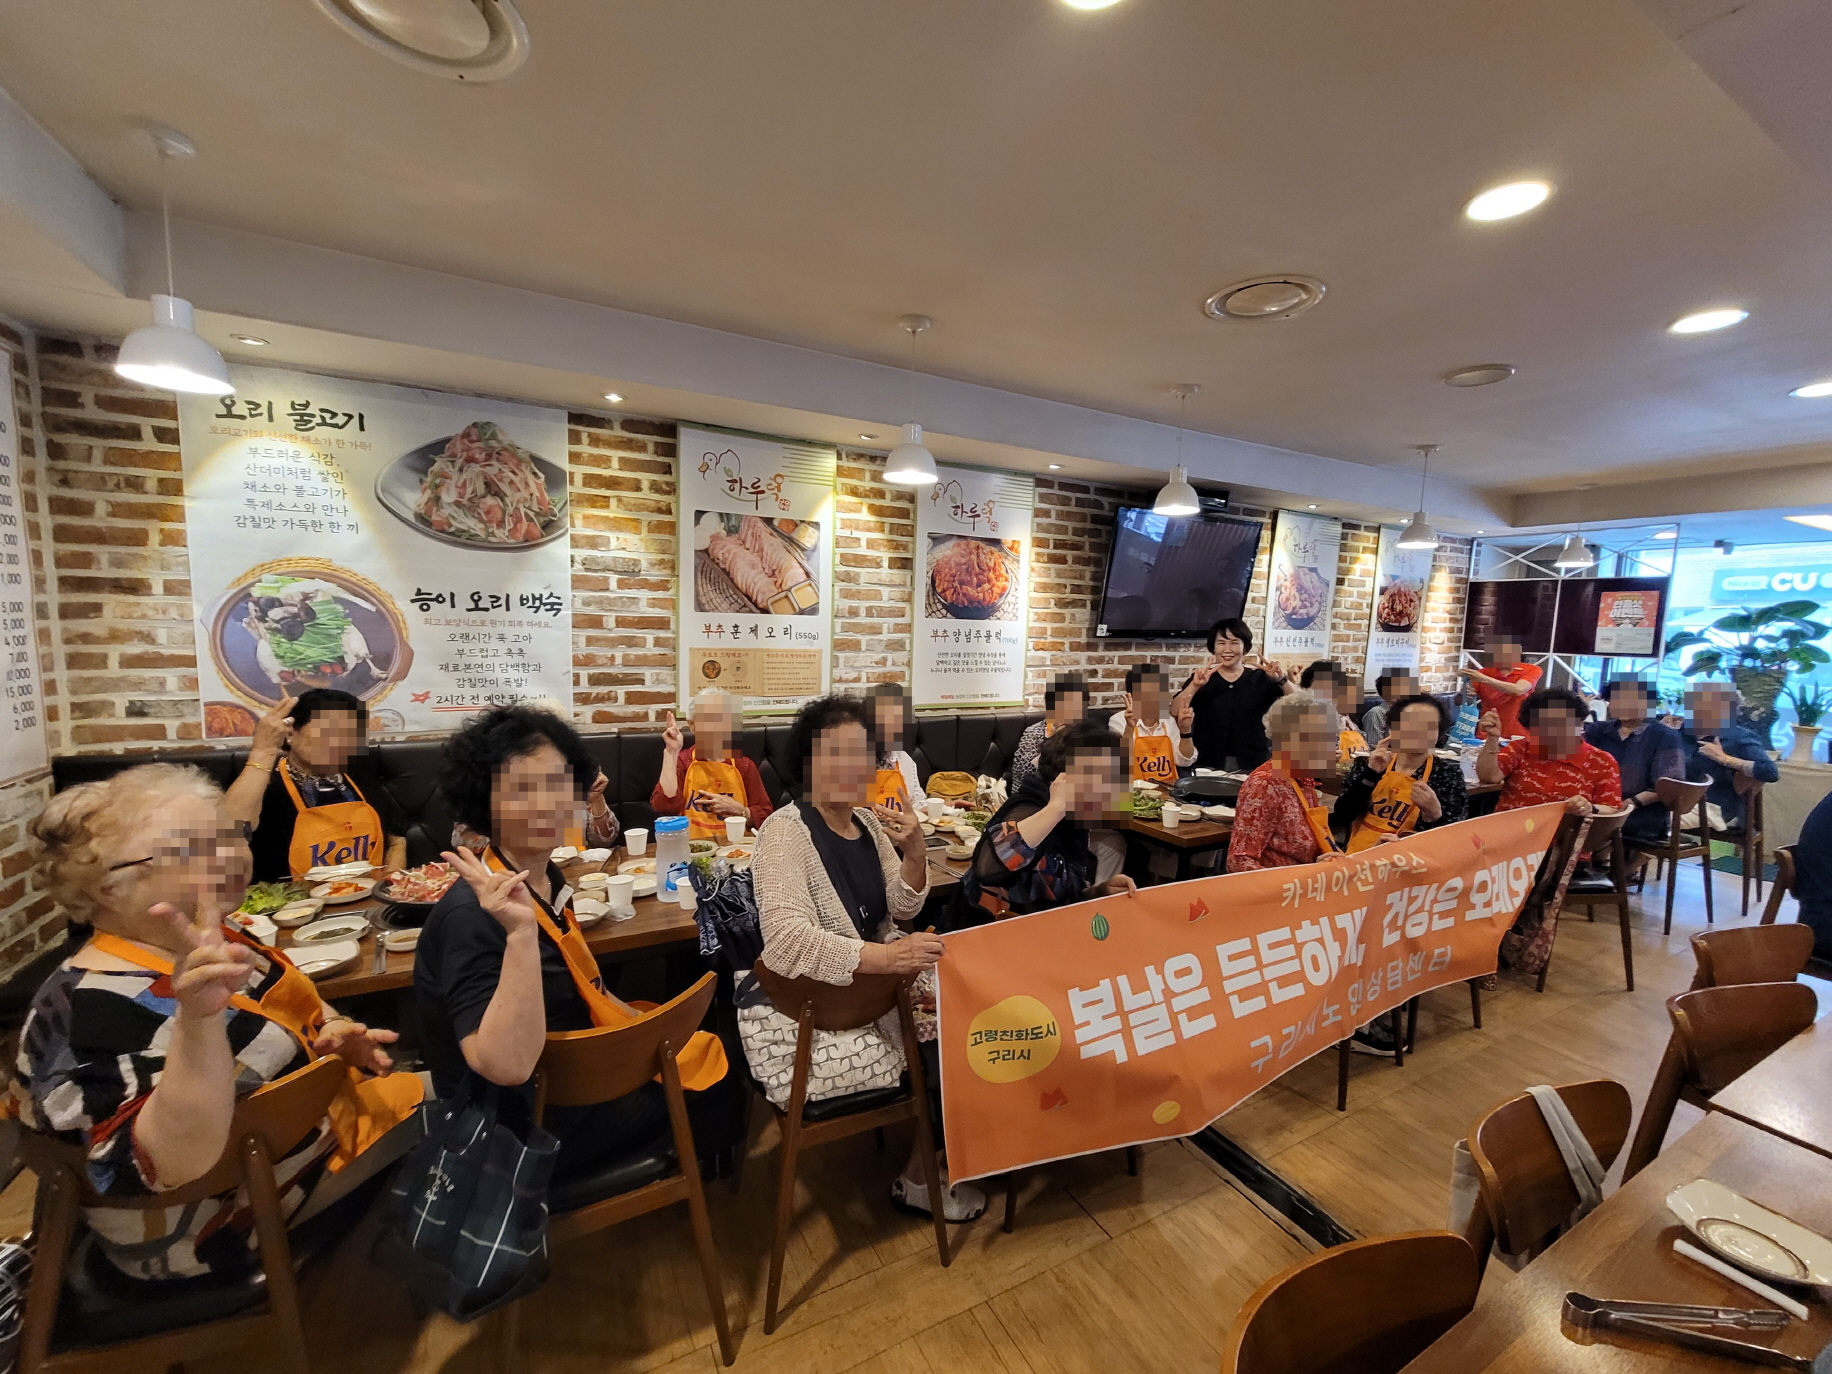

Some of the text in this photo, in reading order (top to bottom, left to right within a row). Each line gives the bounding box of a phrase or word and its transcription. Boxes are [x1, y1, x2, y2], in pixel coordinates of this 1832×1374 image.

[215, 394, 366, 432] 오리 불고기
[208, 426, 265, 439] 오리고기와
[335, 438, 346, 449] 한
[246, 446, 341, 468] 부드러운 식감,
[244, 463, 312, 481] 산더미처럼
[243, 480, 348, 501] 채소와 불고기가
[243, 498, 350, 517] 특제소스와 만나
[234, 514, 360, 535] 감칠맛 가득한 한 끼
[1771, 572, 1819, 592] CU
[410, 587, 563, 618] 능이 오리 백숙
[443, 618, 488, 628] 보양식으로
[702, 623, 726, 640] 부추
[795, 631, 819, 640] (550g)
[495, 633, 508, 644] 푹
[510, 633, 533, 644] 고아
[930, 628, 950, 643] 부추
[454, 648, 527, 659] 부드럽고 촉촉
[438, 662, 543, 674] 재료본연의 담백함과
[455, 677, 528, 689] 감칠맛이 폭발!
[436, 694, 465, 706] 2시간
[469, 694, 480, 705] 전
[483, 693, 506, 705] 예약
[13, 715, 37, 732] 2,000
[1136, 755, 1172, 777] Kelly
[309, 834, 377, 867] Kell
[1067, 952, 1217, 1065] 복날은
[1382, 876, 1464, 948] 건강은
[970, 1021, 1057, 1047] 고령친화도시
[987, 1048, 1031, 1065] 구리시
